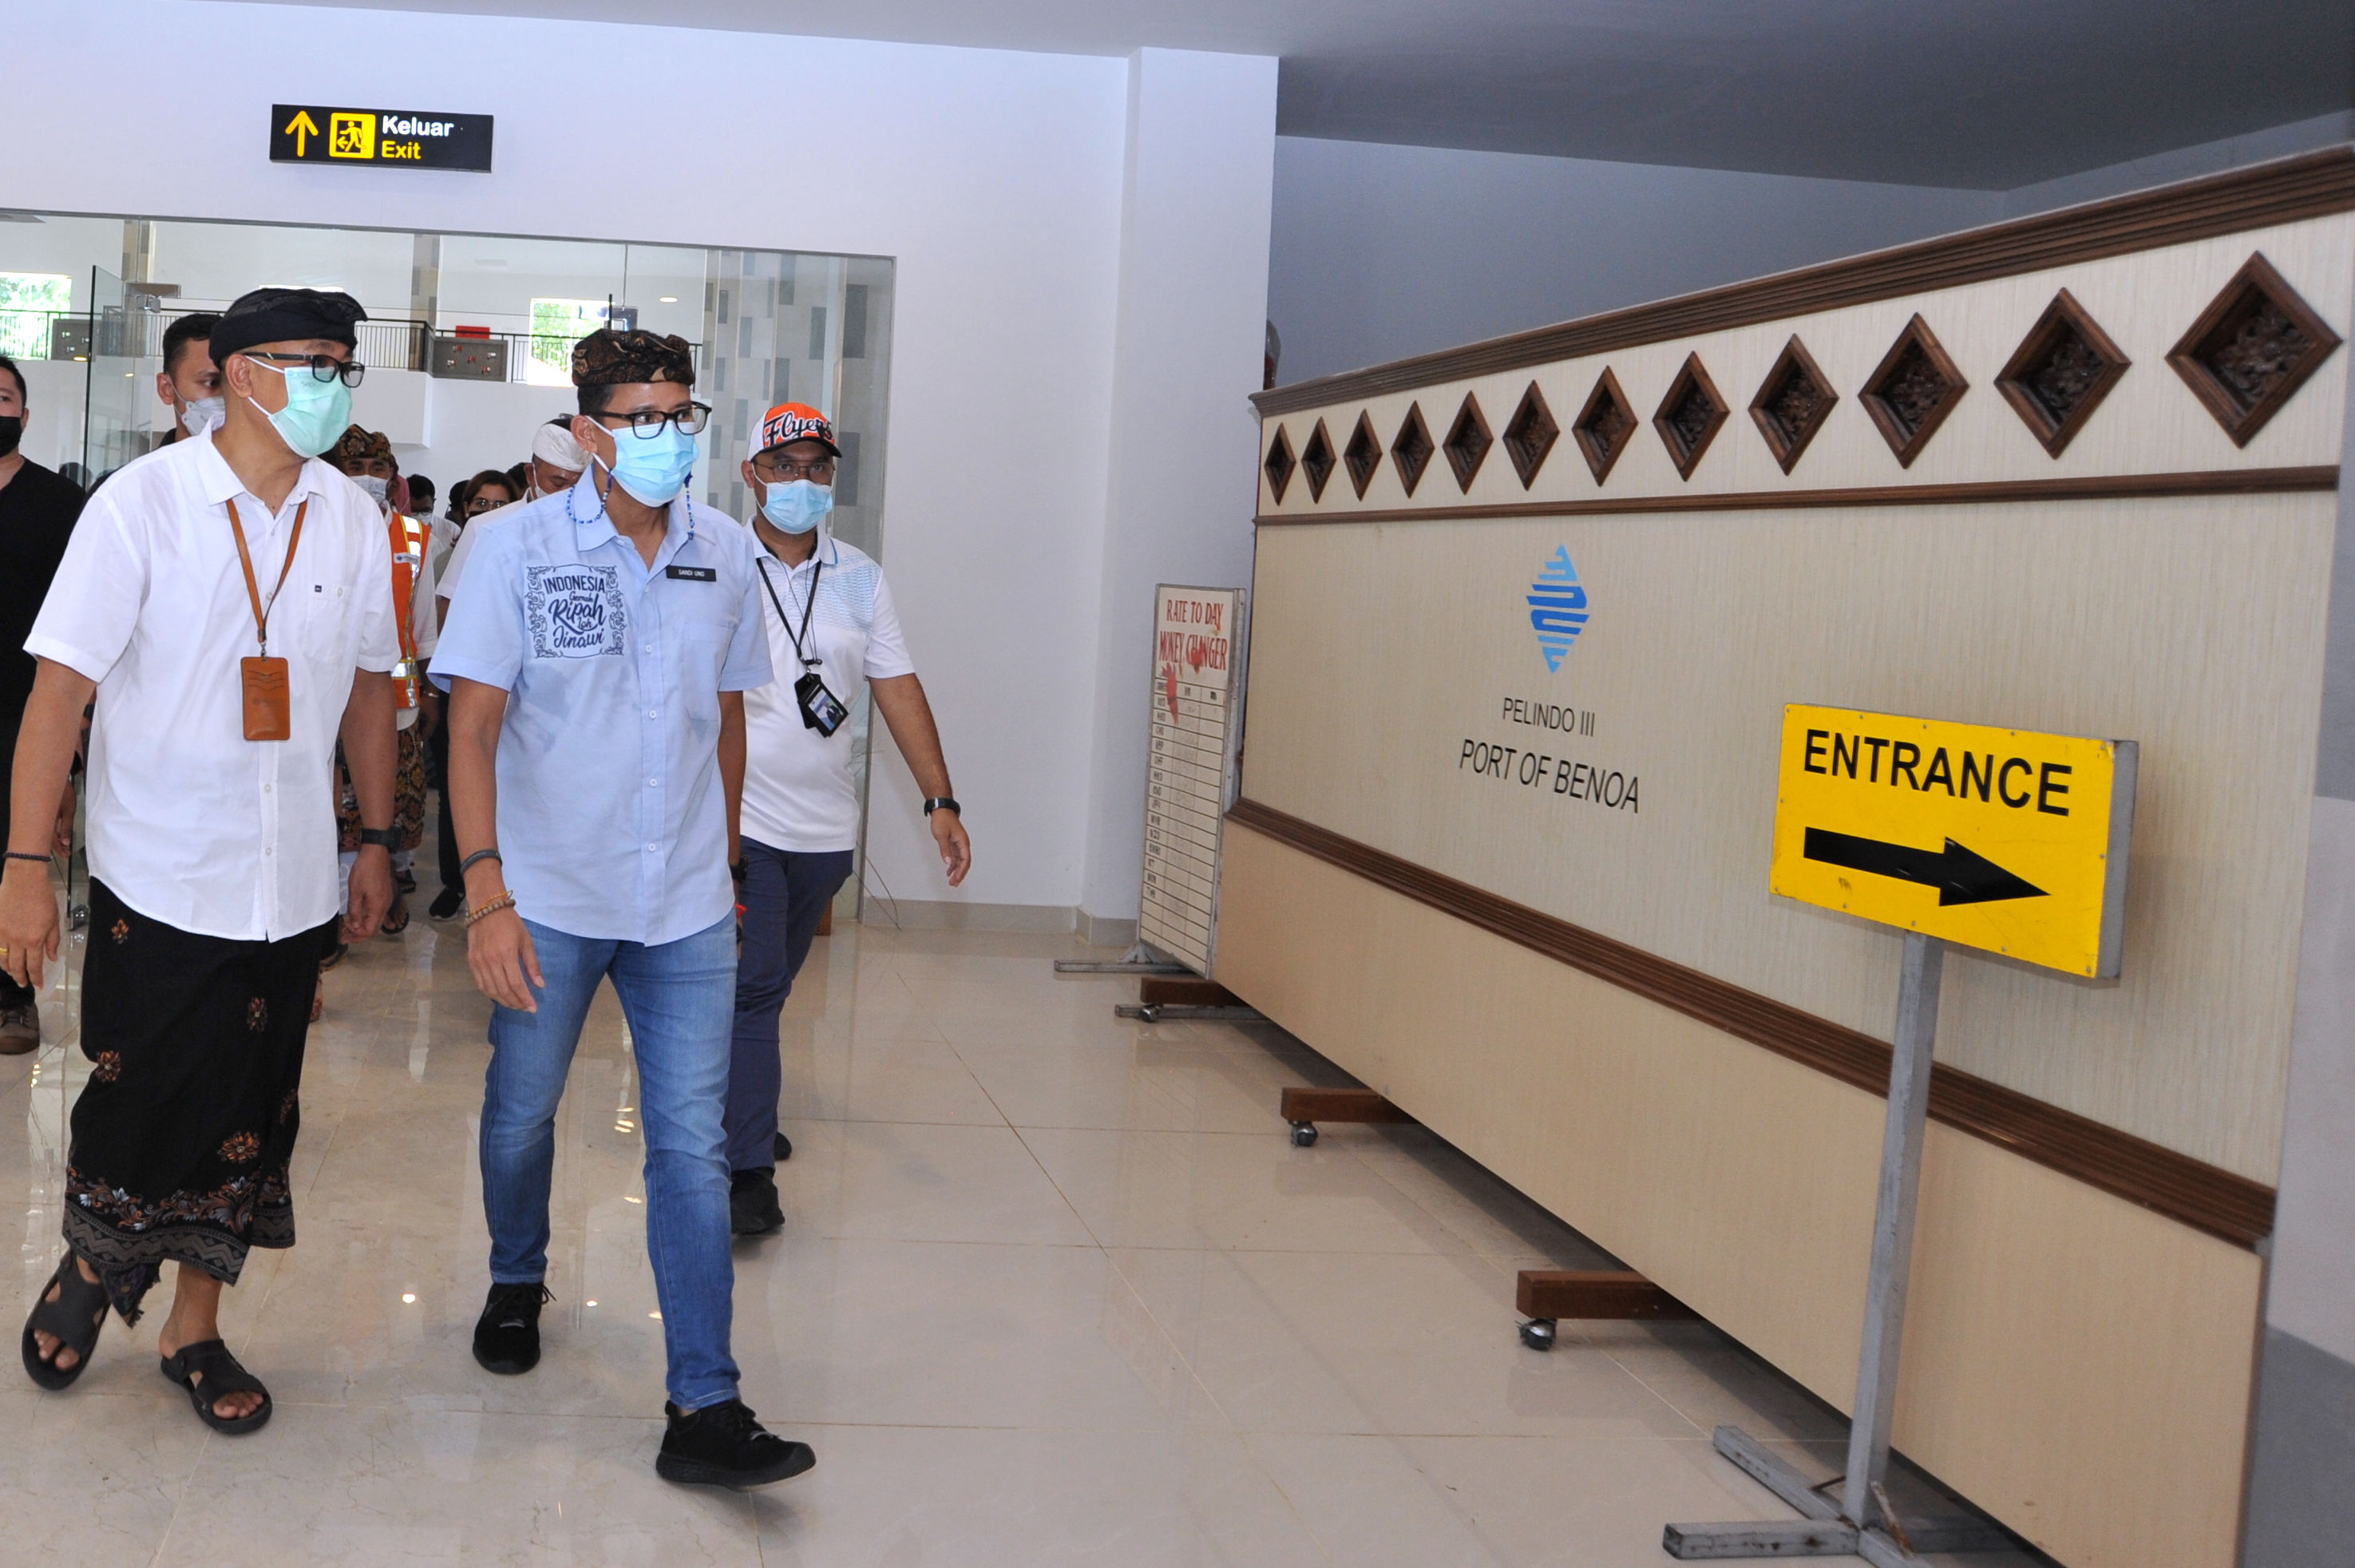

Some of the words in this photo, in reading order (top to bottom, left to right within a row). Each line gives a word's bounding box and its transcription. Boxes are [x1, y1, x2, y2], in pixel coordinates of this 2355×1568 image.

[382, 116, 454, 137] Keluar
[382, 141, 422, 160] Exit
[763, 410, 833, 446] Flyers
[542, 575, 605, 594] INDONESIA
[548, 593, 607, 636] Ripah
[1166, 600, 1188, 623] RATE
[1191, 601, 1203, 624] TO
[1205, 603, 1224, 626] DAY
[552, 625, 605, 648] Jinawi
[1159, 631, 1185, 663] MONEY
[1502, 697, 1575, 733] PELINDO
[1580, 710, 1596, 737] III
[1459, 738, 1518, 780] PORT
[1519, 752, 1552, 788] OF
[1554, 759, 1639, 814] BENOA
[1803, 728, 2073, 818] ENTRANCE
